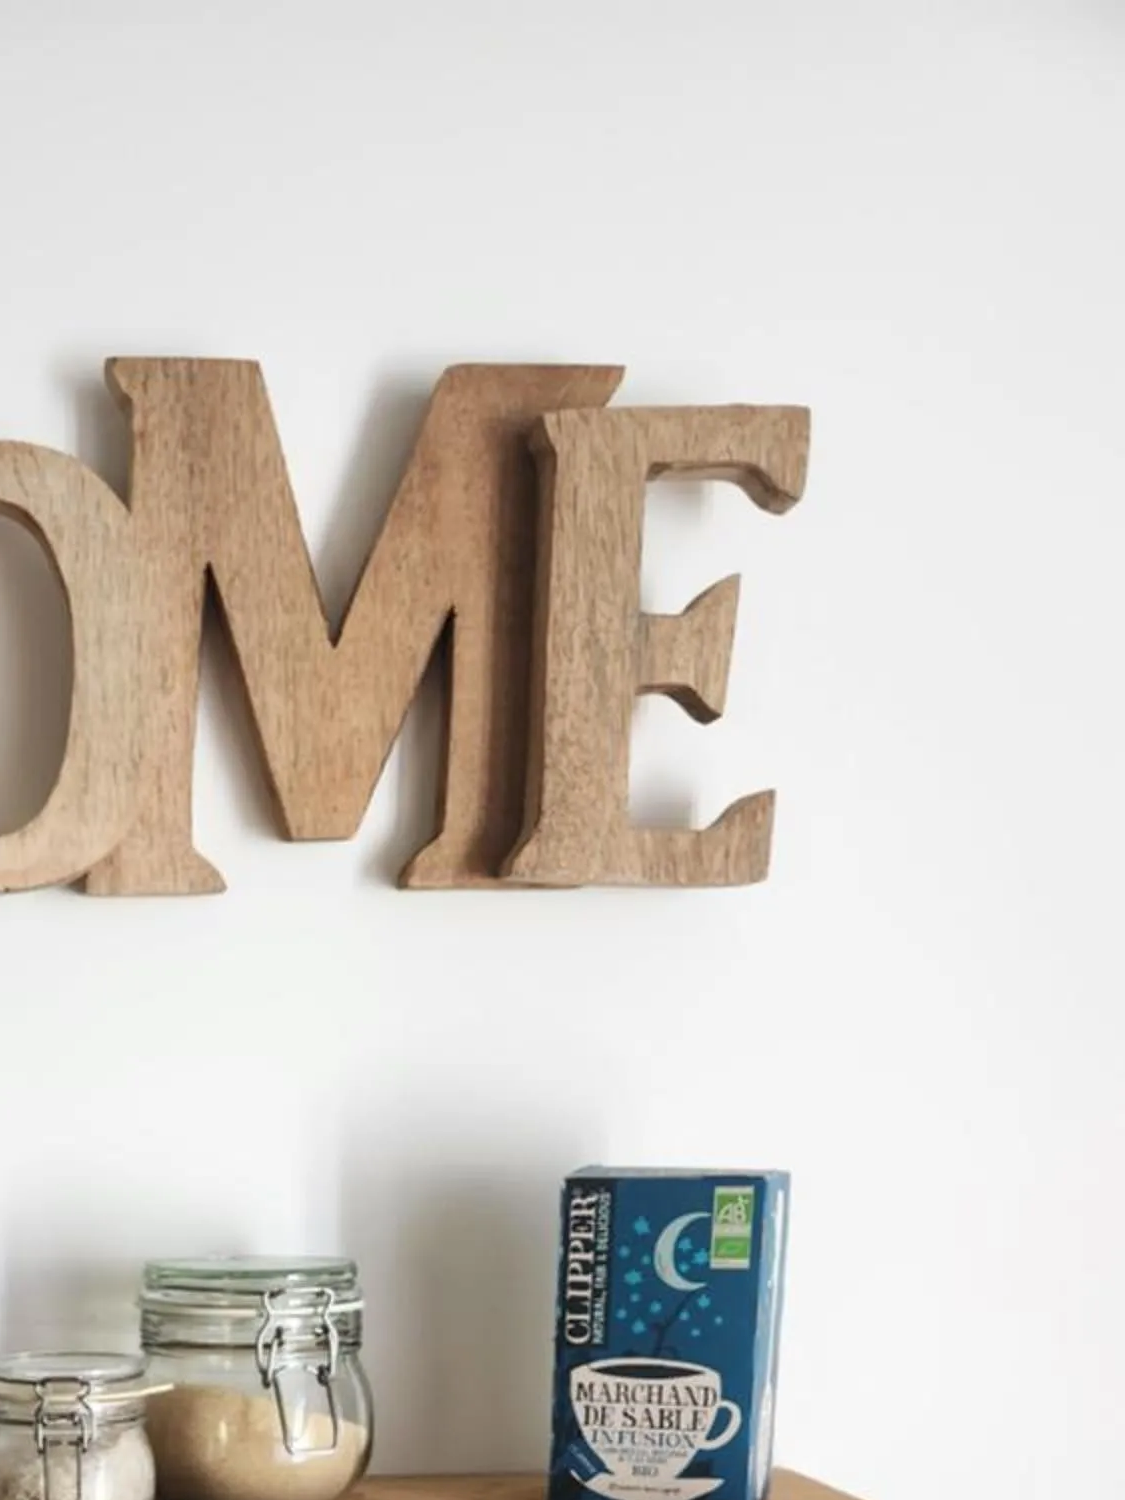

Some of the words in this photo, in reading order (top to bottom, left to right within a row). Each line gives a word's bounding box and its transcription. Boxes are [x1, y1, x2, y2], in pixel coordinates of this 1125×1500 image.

[565, 1193, 599, 1345] CLIPPER
[576, 1381, 718, 1407] MARCHAND
[584, 1405, 615, 1427] DE
[622, 1407, 707, 1432] SABLE
[591, 1429, 697, 1449] INFUSION
